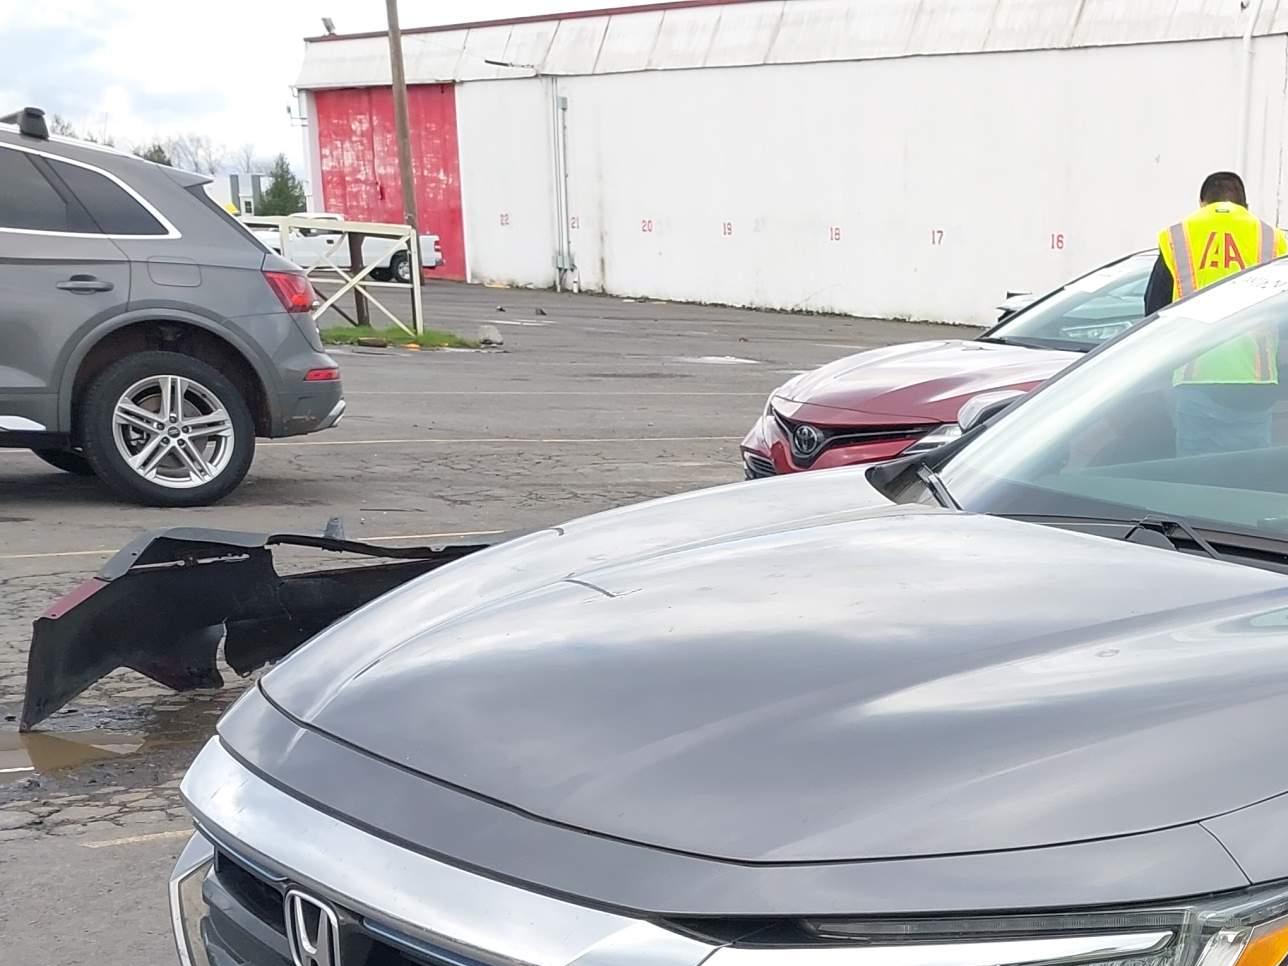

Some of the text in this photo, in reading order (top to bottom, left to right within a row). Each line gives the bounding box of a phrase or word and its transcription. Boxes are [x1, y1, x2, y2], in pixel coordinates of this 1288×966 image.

[642, 220, 653, 232] 20
[722, 222, 732, 235] 19
[829, 227, 841, 241] 18
[931, 230, 944, 245] 17
[1050, 234, 1064, 249] 16
